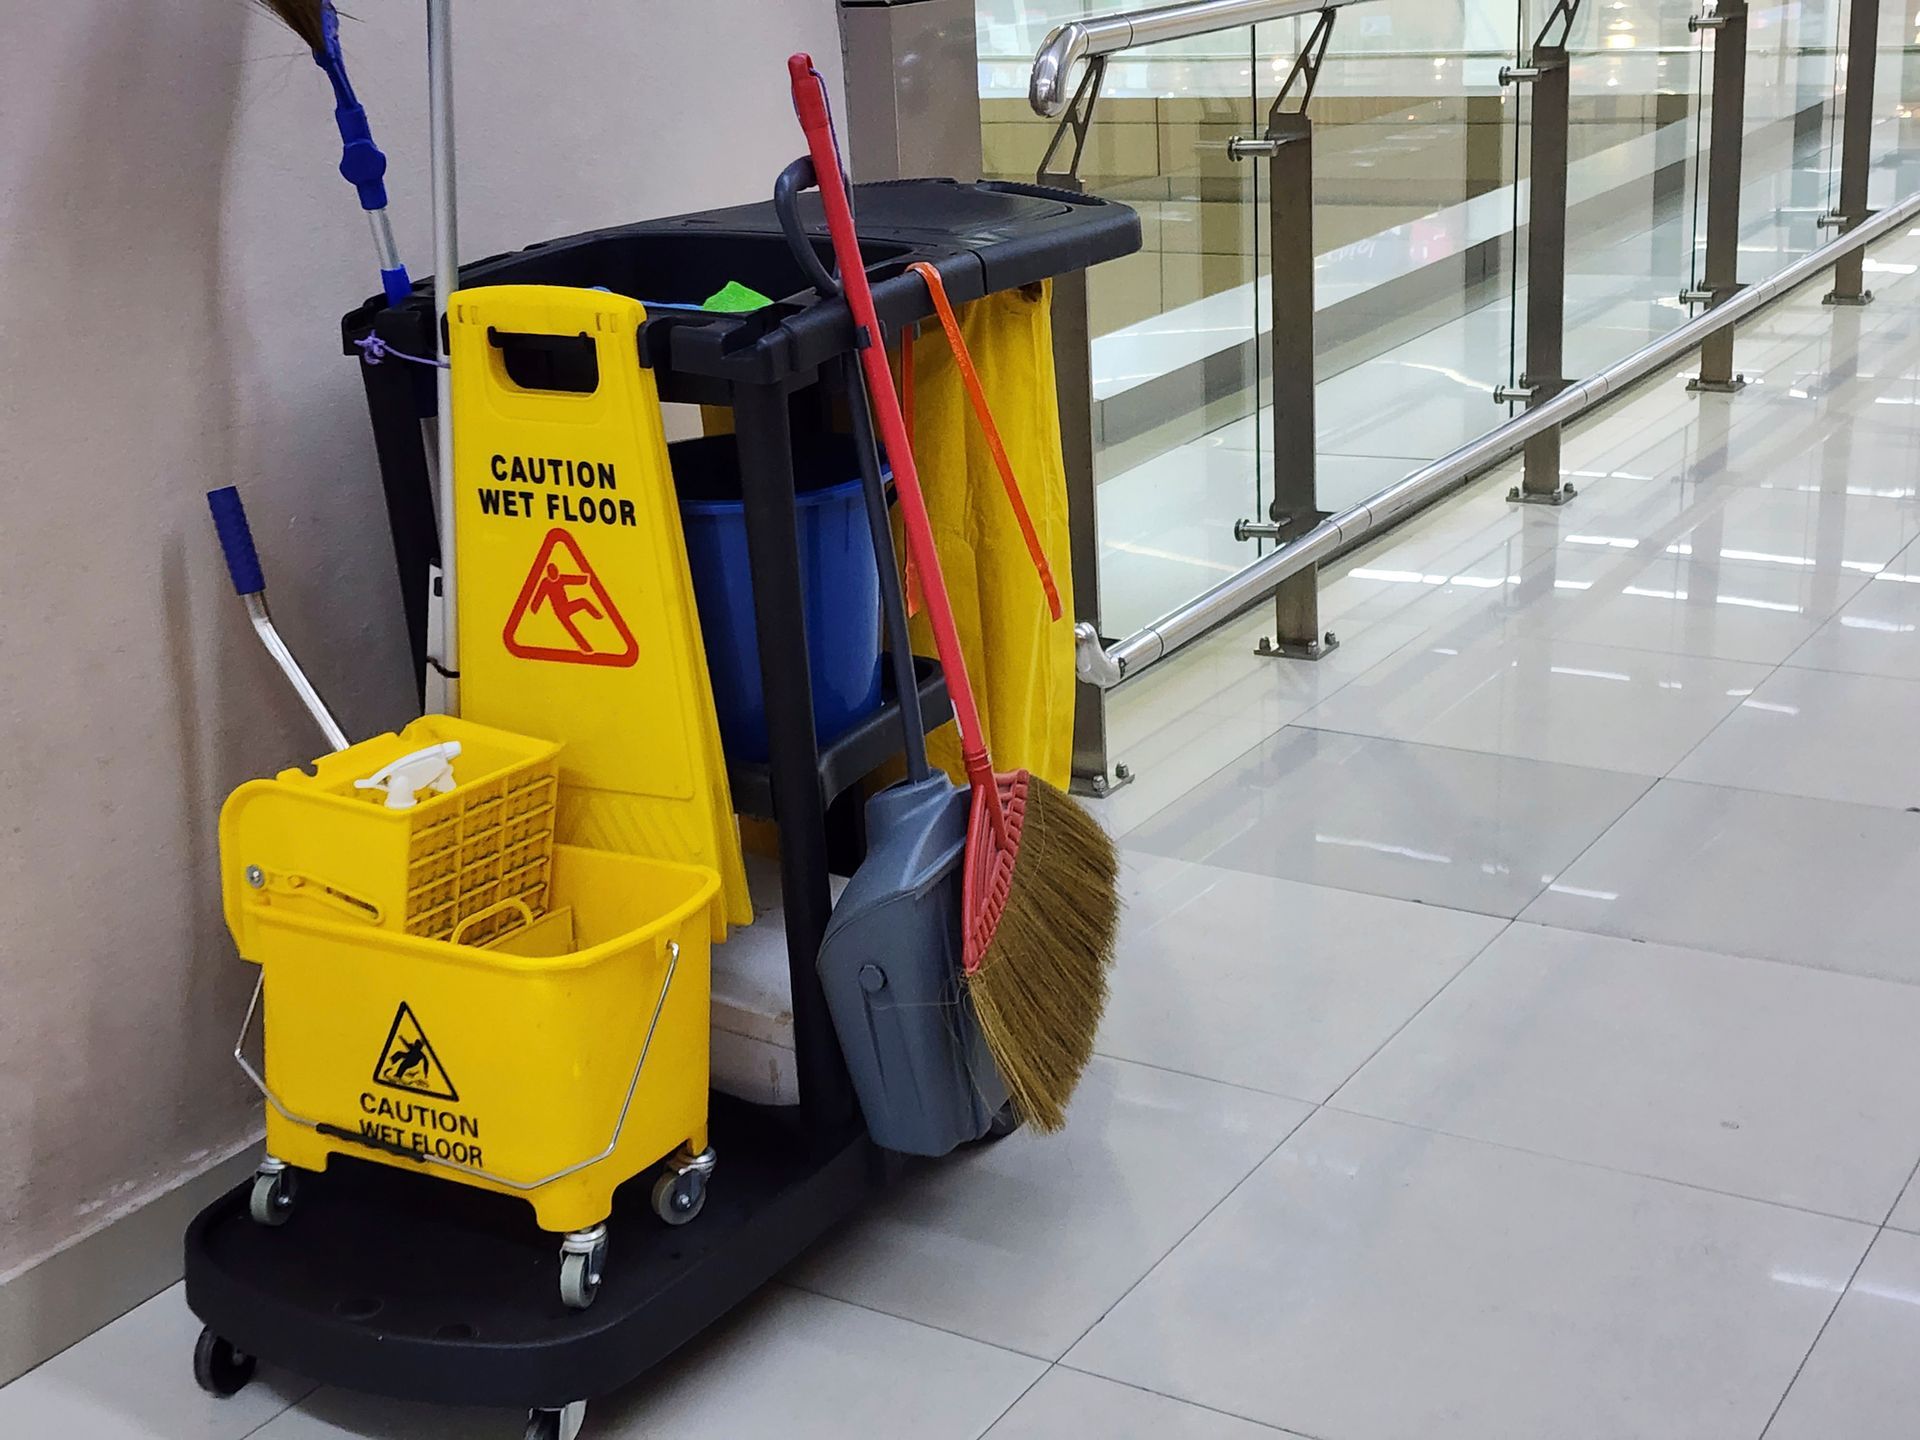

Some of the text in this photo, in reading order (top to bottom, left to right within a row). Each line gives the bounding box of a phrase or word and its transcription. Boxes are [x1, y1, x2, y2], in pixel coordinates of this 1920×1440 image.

[490, 454, 617, 490] CAUTION
[478, 488, 637, 527] WET FLOOR
[360, 1092, 479, 1138] CAUTION
[359, 1119, 484, 1168] WET FLOOR
